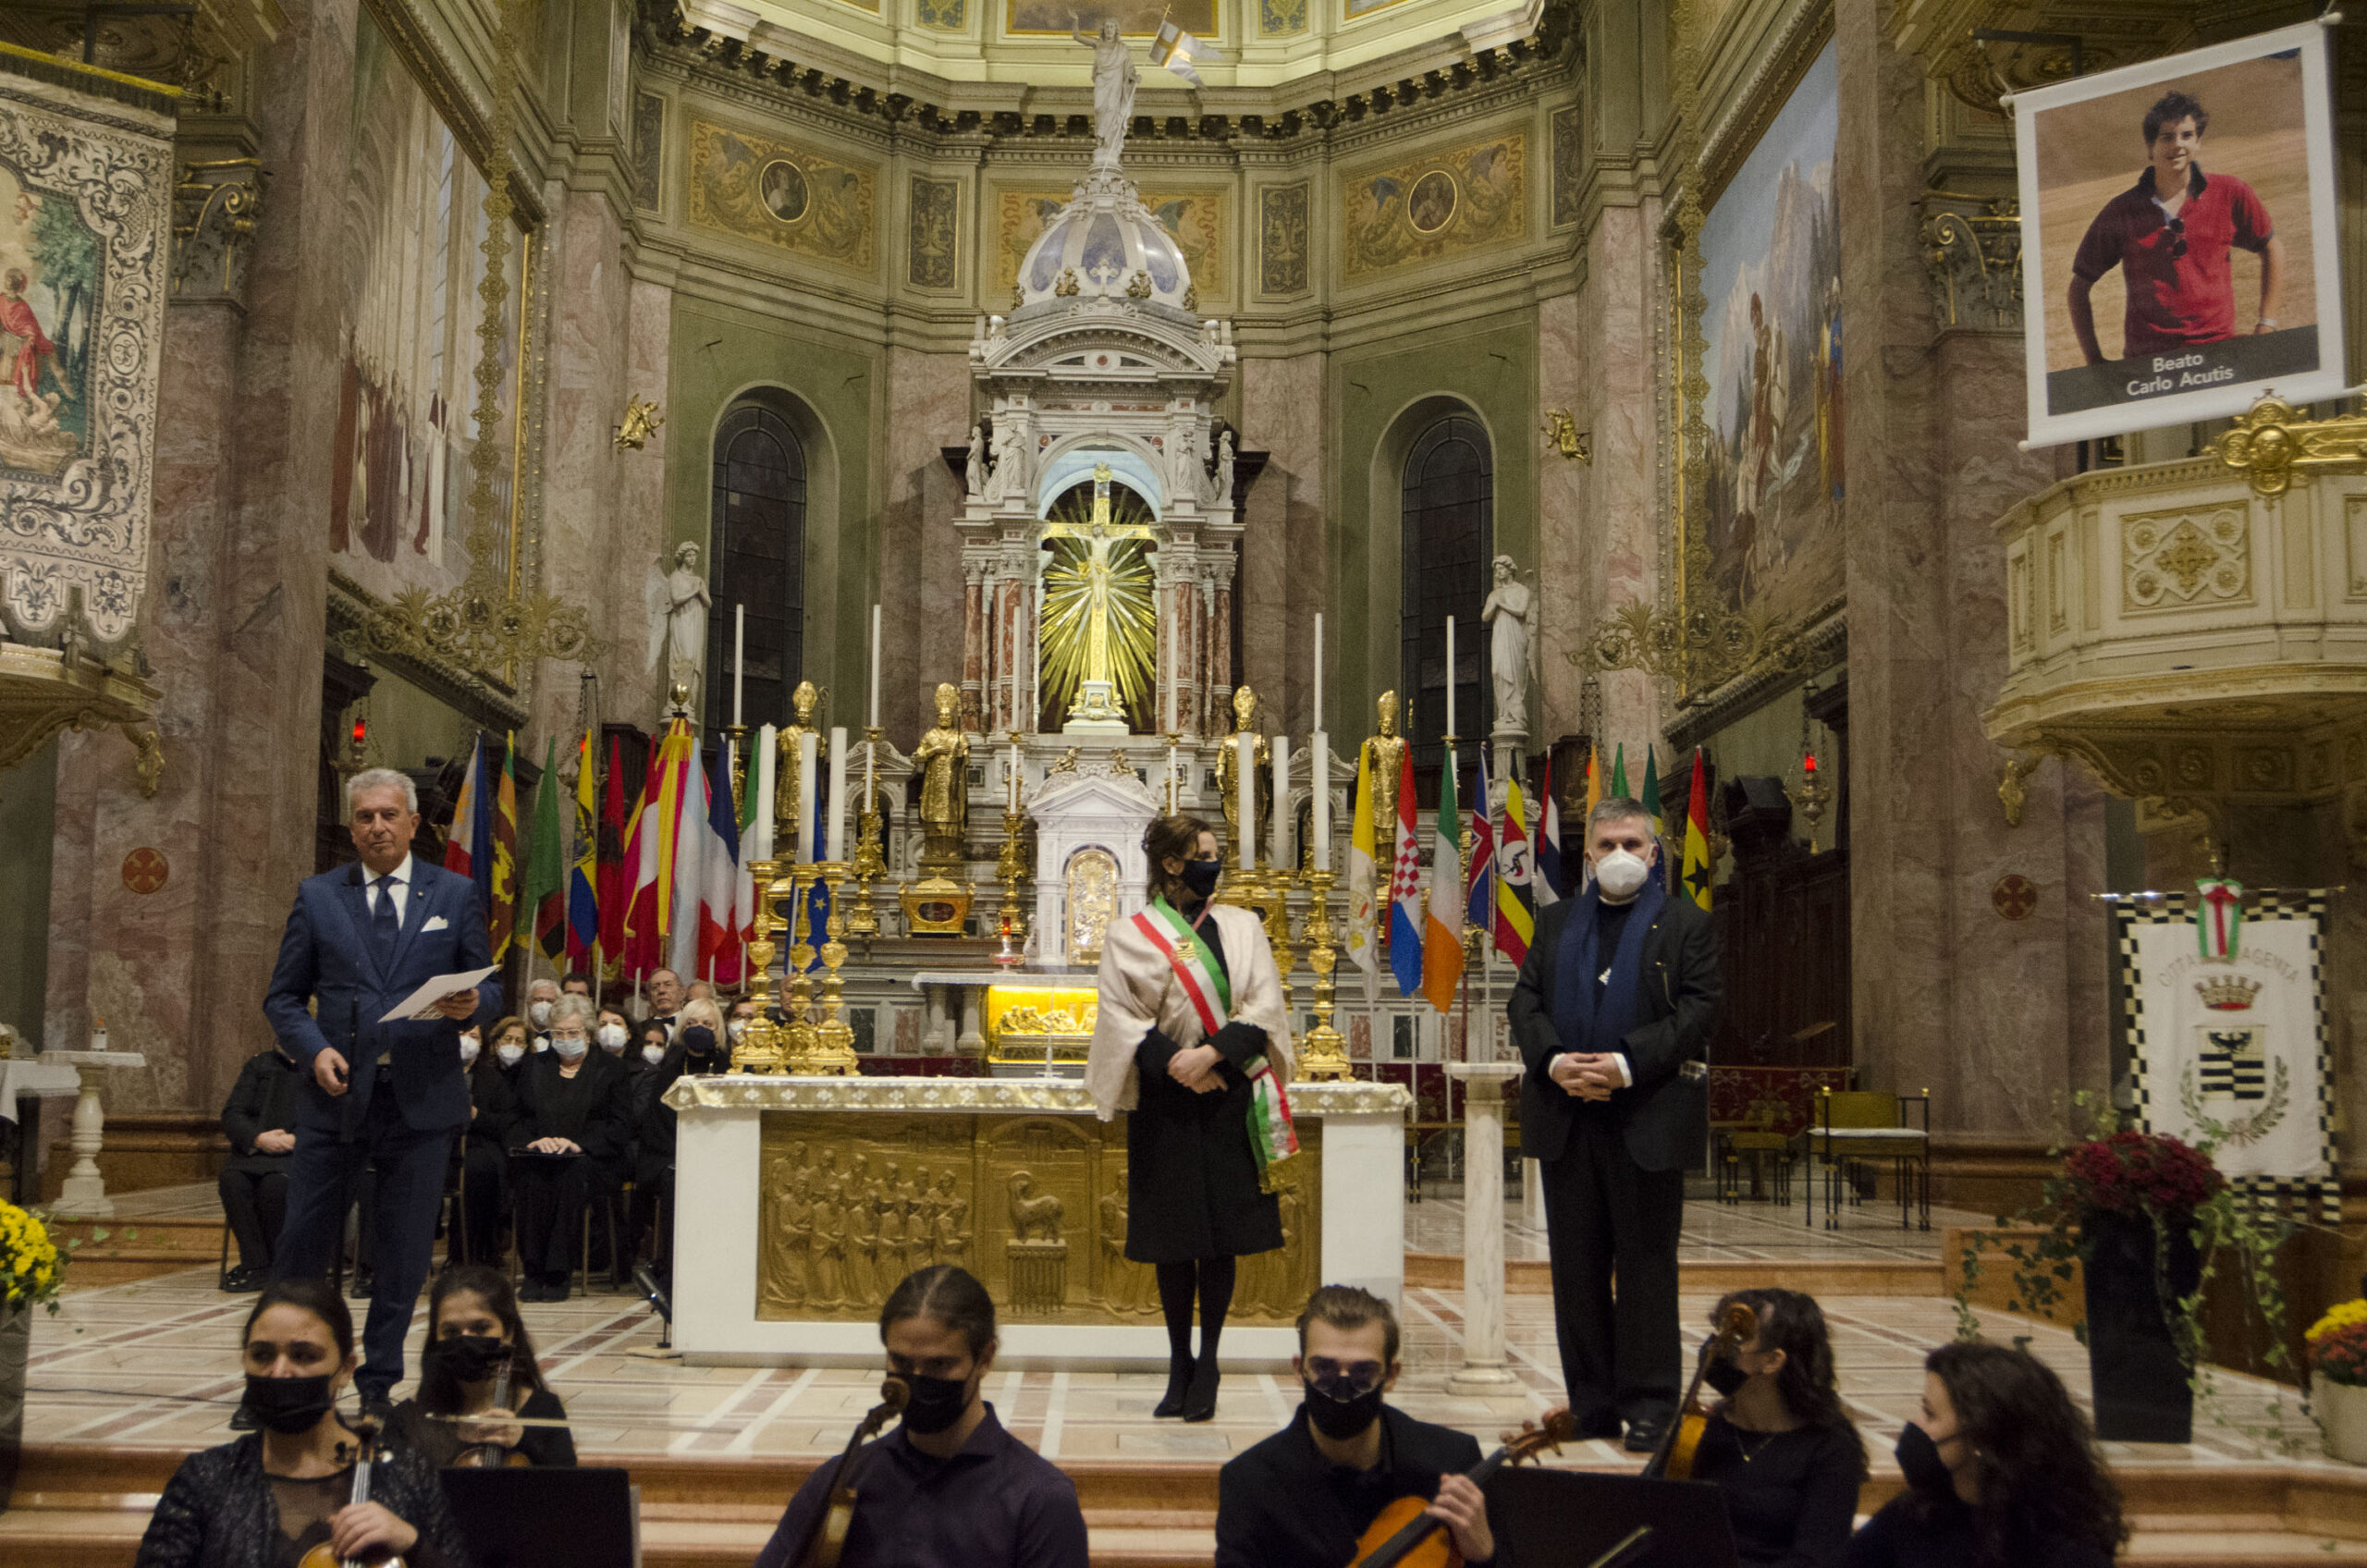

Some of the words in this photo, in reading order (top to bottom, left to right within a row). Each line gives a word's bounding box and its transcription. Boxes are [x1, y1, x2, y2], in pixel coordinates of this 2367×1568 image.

[2152, 354, 2204, 373] Beato
[2127, 375, 2173, 396] Carlo
[2178, 365, 2234, 387] Acutis
[2242, 946, 2300, 985] AGENTA
